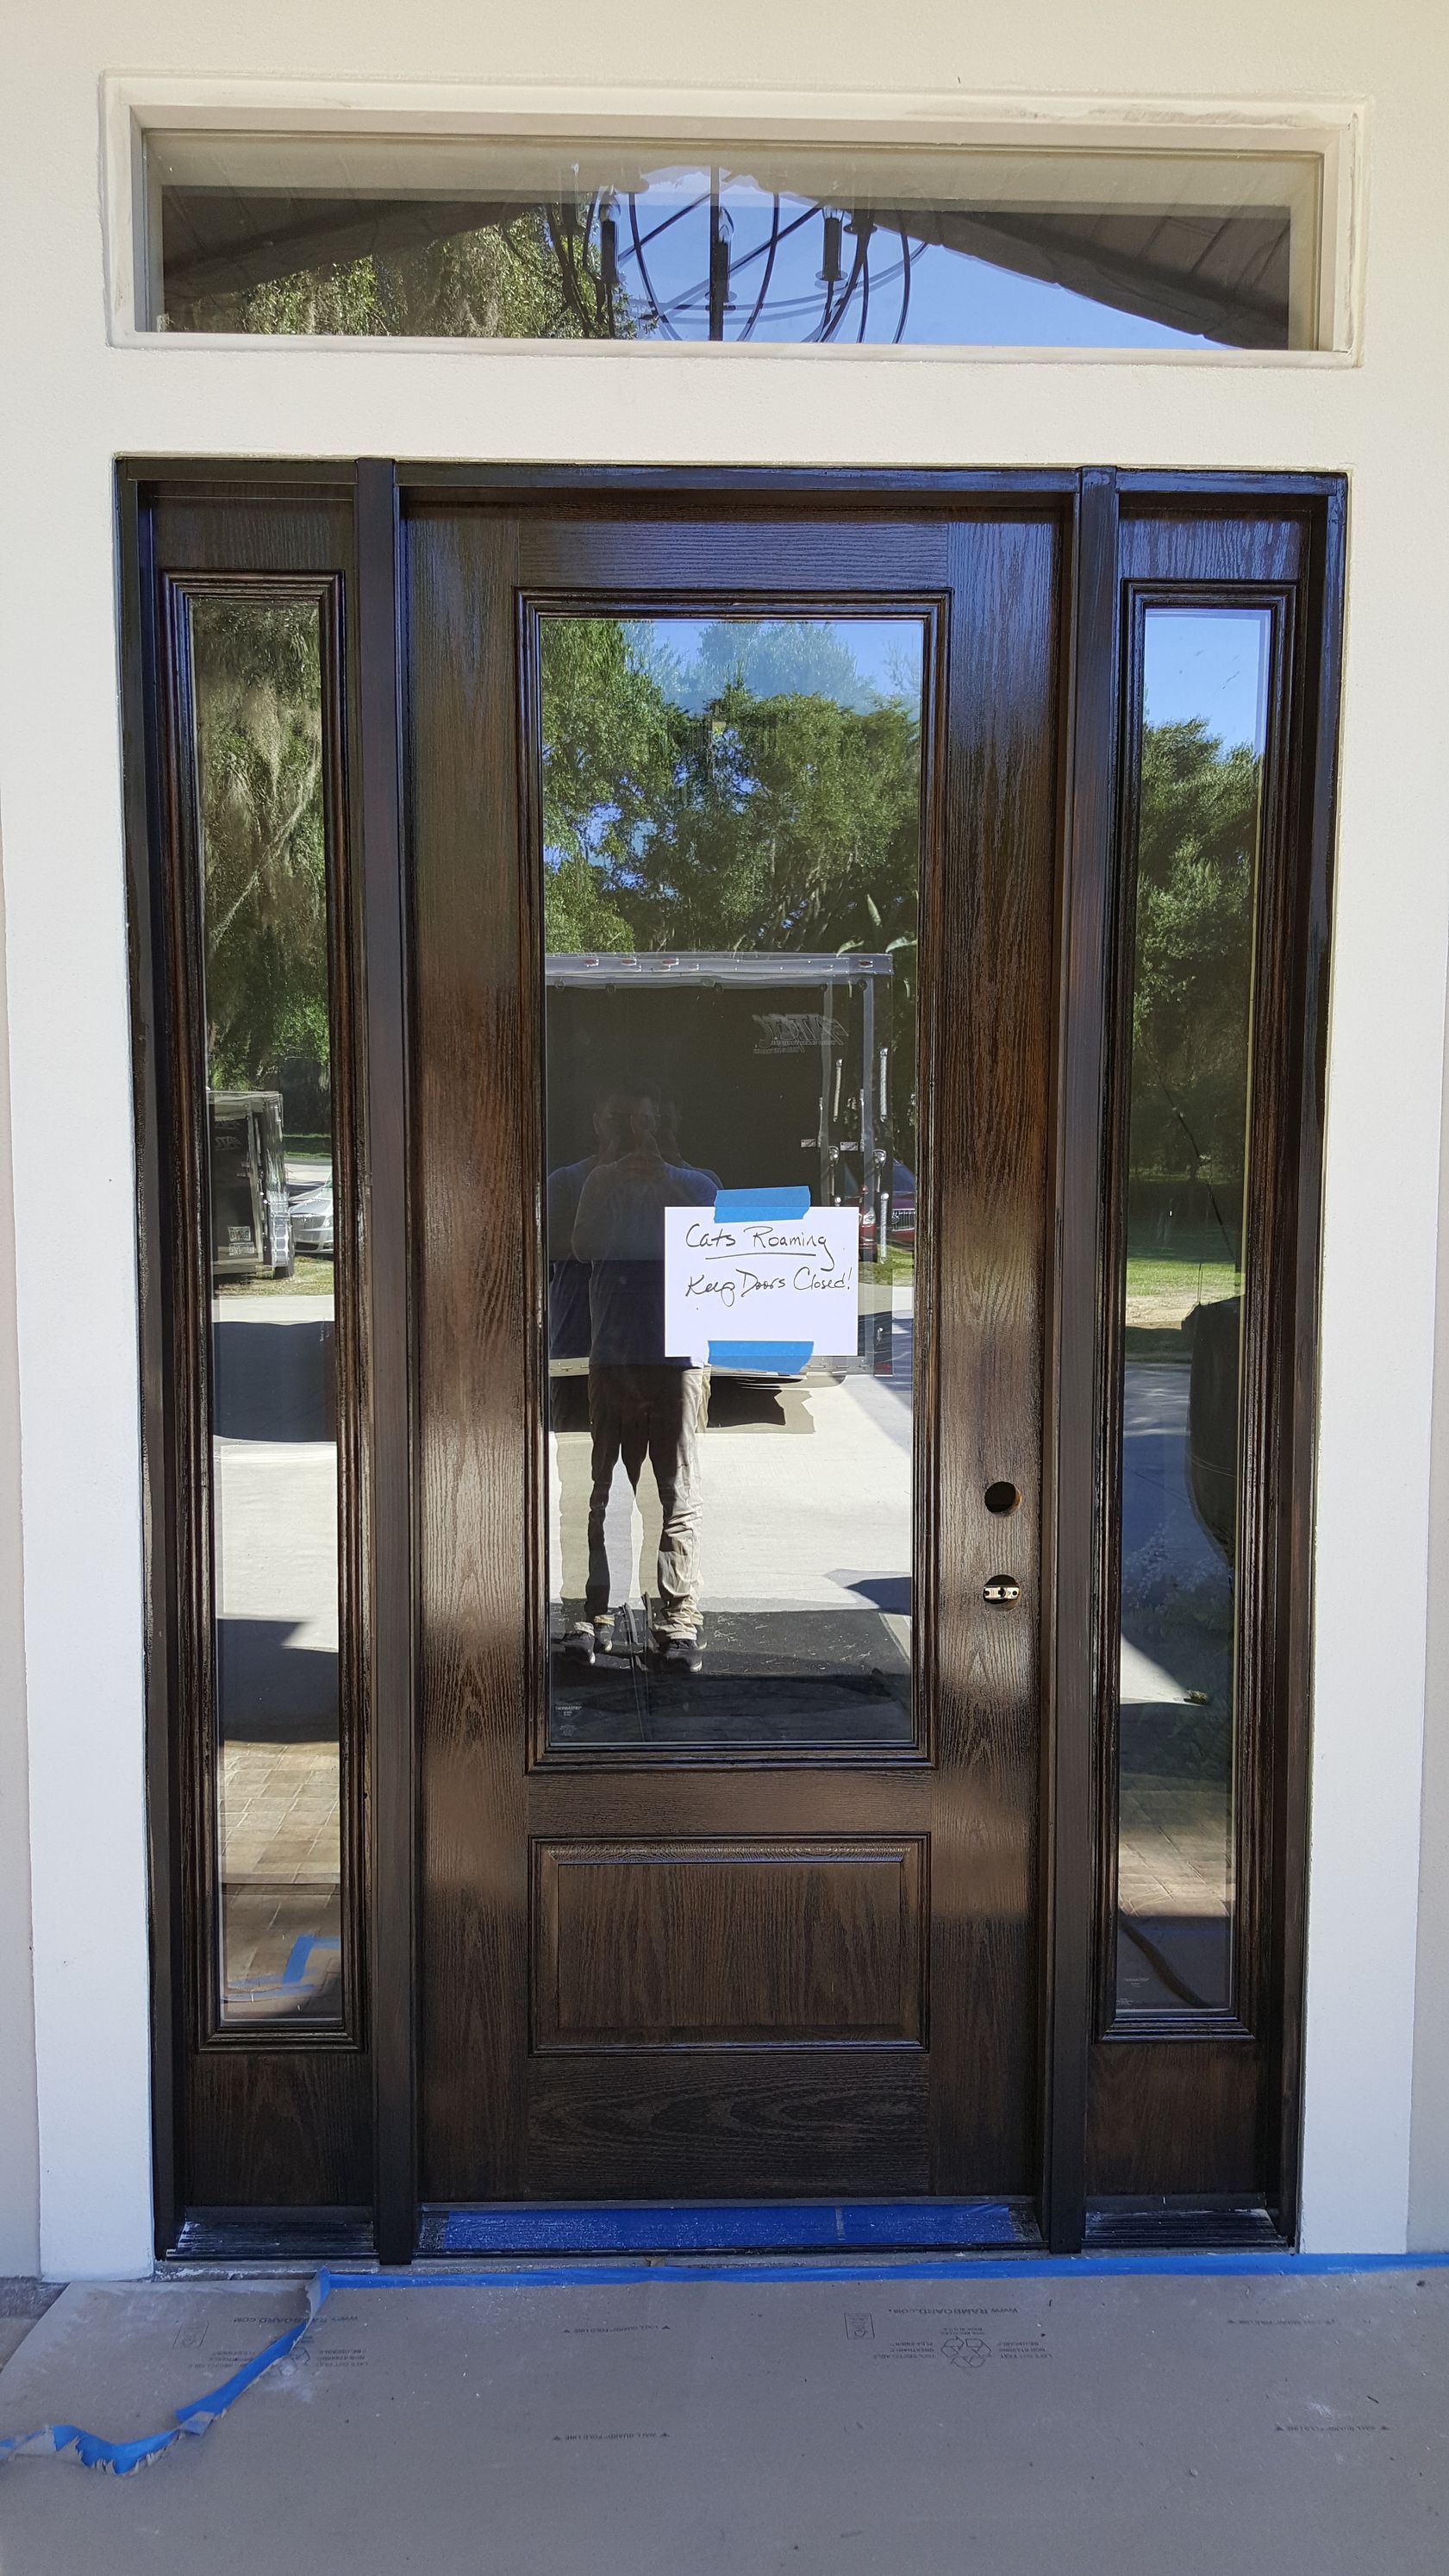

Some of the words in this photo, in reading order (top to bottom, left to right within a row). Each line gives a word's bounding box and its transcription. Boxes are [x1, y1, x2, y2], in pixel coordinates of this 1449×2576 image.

[685, 1222, 736, 1248] Cats
[743, 1225, 835, 1272] Roaming
[684, 1274, 736, 1307] Keep
[735, 1268, 786, 1297] Doors
[793, 1266, 853, 1291] Closed!
